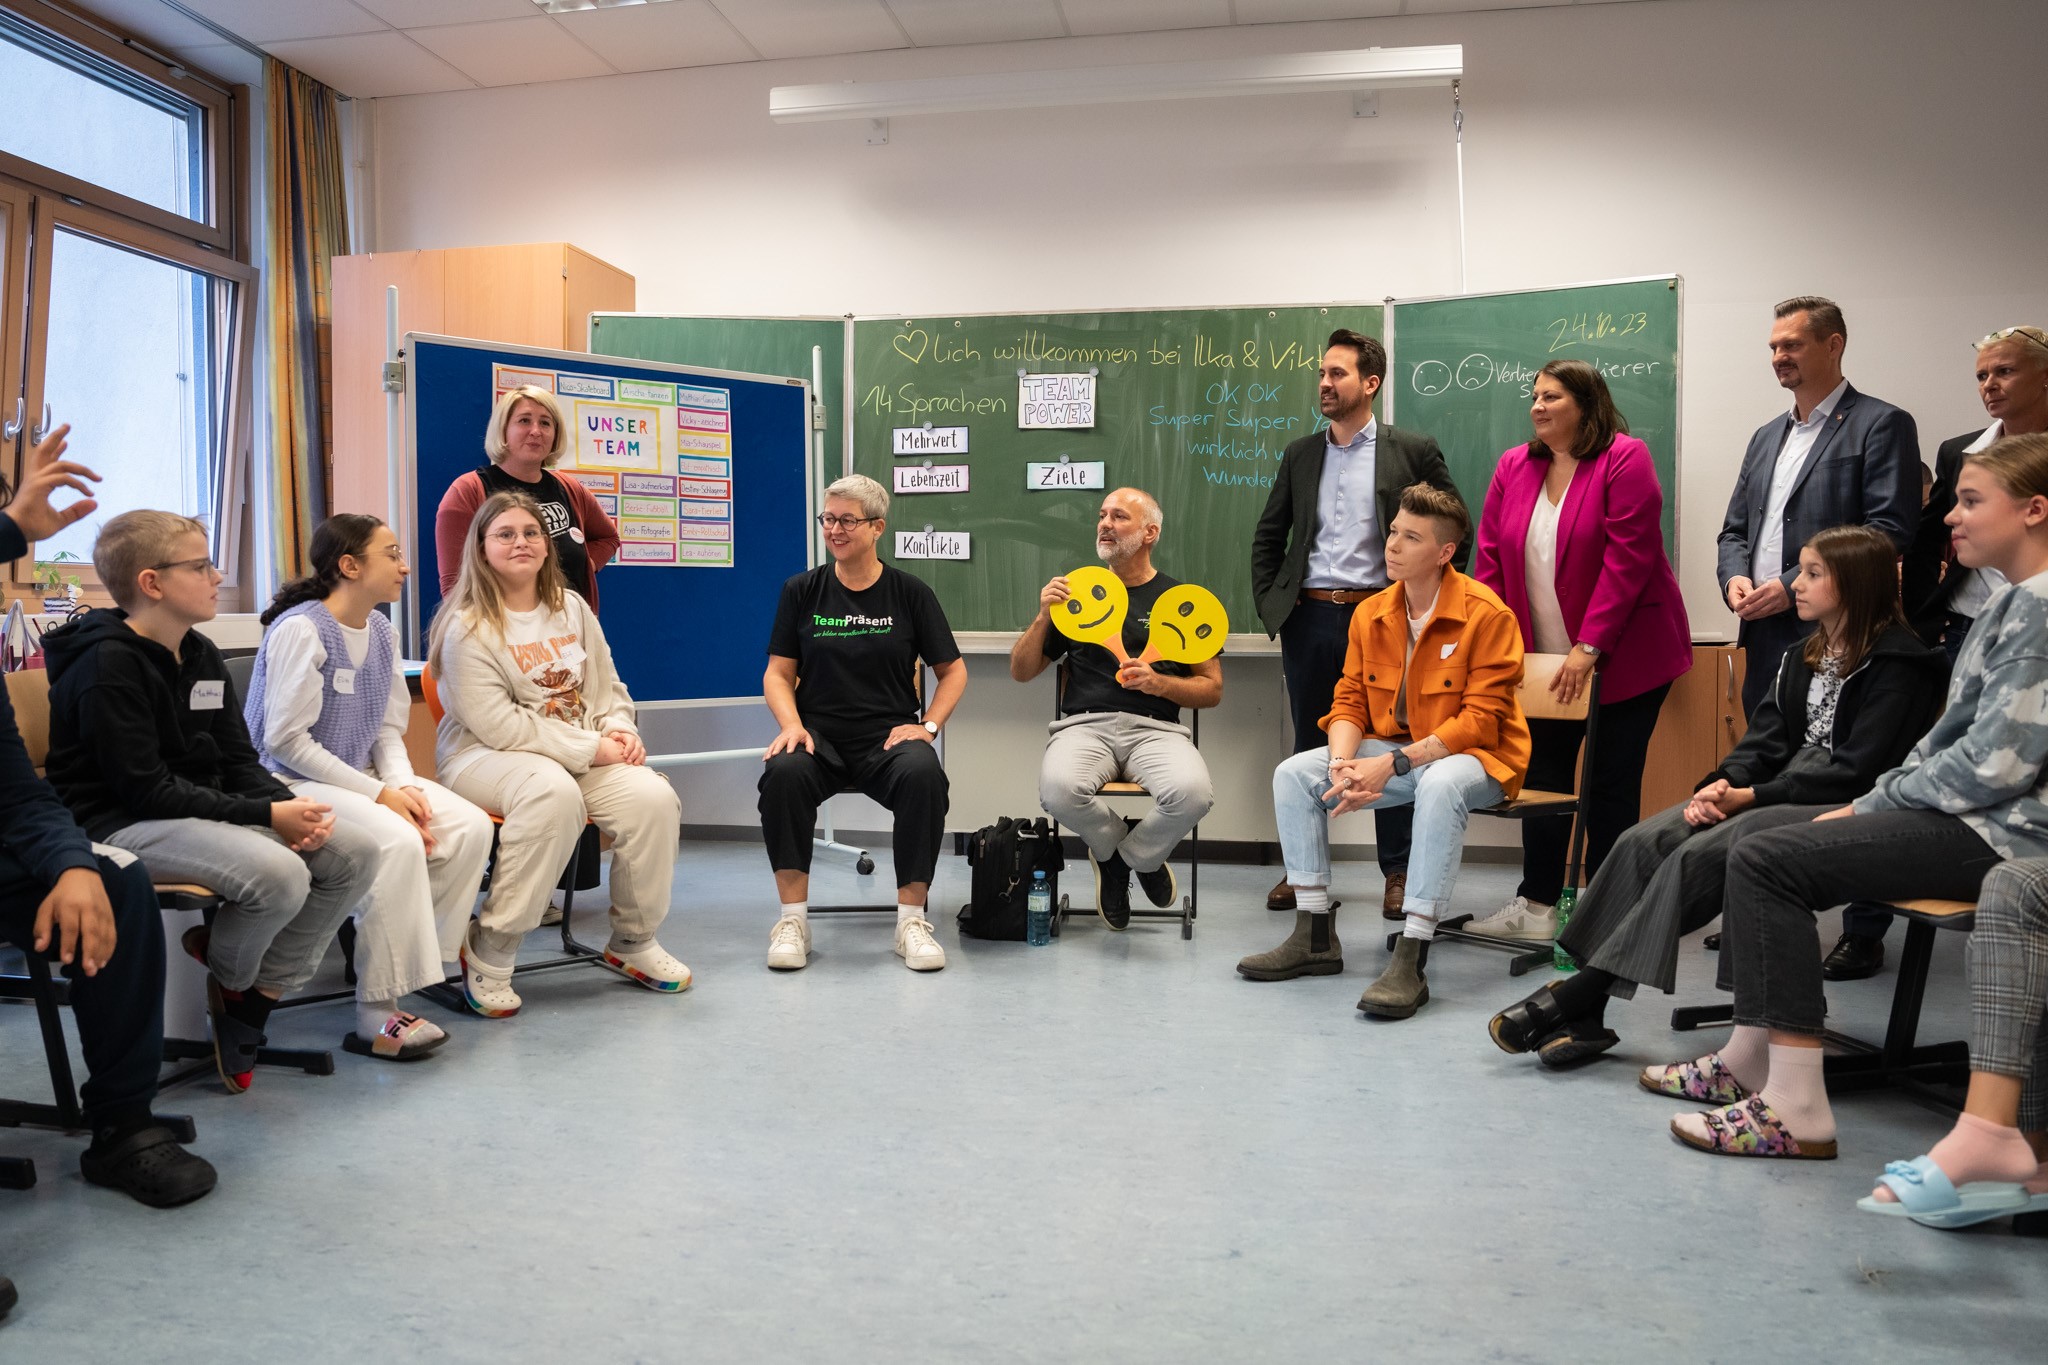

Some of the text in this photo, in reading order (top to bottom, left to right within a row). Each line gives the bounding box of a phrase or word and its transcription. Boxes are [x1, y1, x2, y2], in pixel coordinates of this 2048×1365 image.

[993, 329, 1137, 363] willkommen
[1147, 338, 1181, 365] bei
[1194, 334, 1235, 369] Ilka
[1243, 340, 1260, 368] &
[1269, 340, 1324, 371] Vikt
[1022, 376, 1091, 401] TEAM
[1206, 382, 1283, 405] OK OK
[861, 382, 1007, 425] 14 Sprachen
[1024, 402, 1092, 425] POWER
[587, 415, 648, 435] UNSER
[1149, 405, 1332, 437] Super Super Ye
[593, 439, 640, 456] TEAM
[901, 429, 959, 450] Mehrwert
[900, 469, 961, 488] Lebenszeit
[1041, 466, 1087, 486] Ziele
[1202, 465, 1277, 488] Wunder
[903, 535, 961, 557] Konflikte
[387, 1016, 419, 1038] FIL
